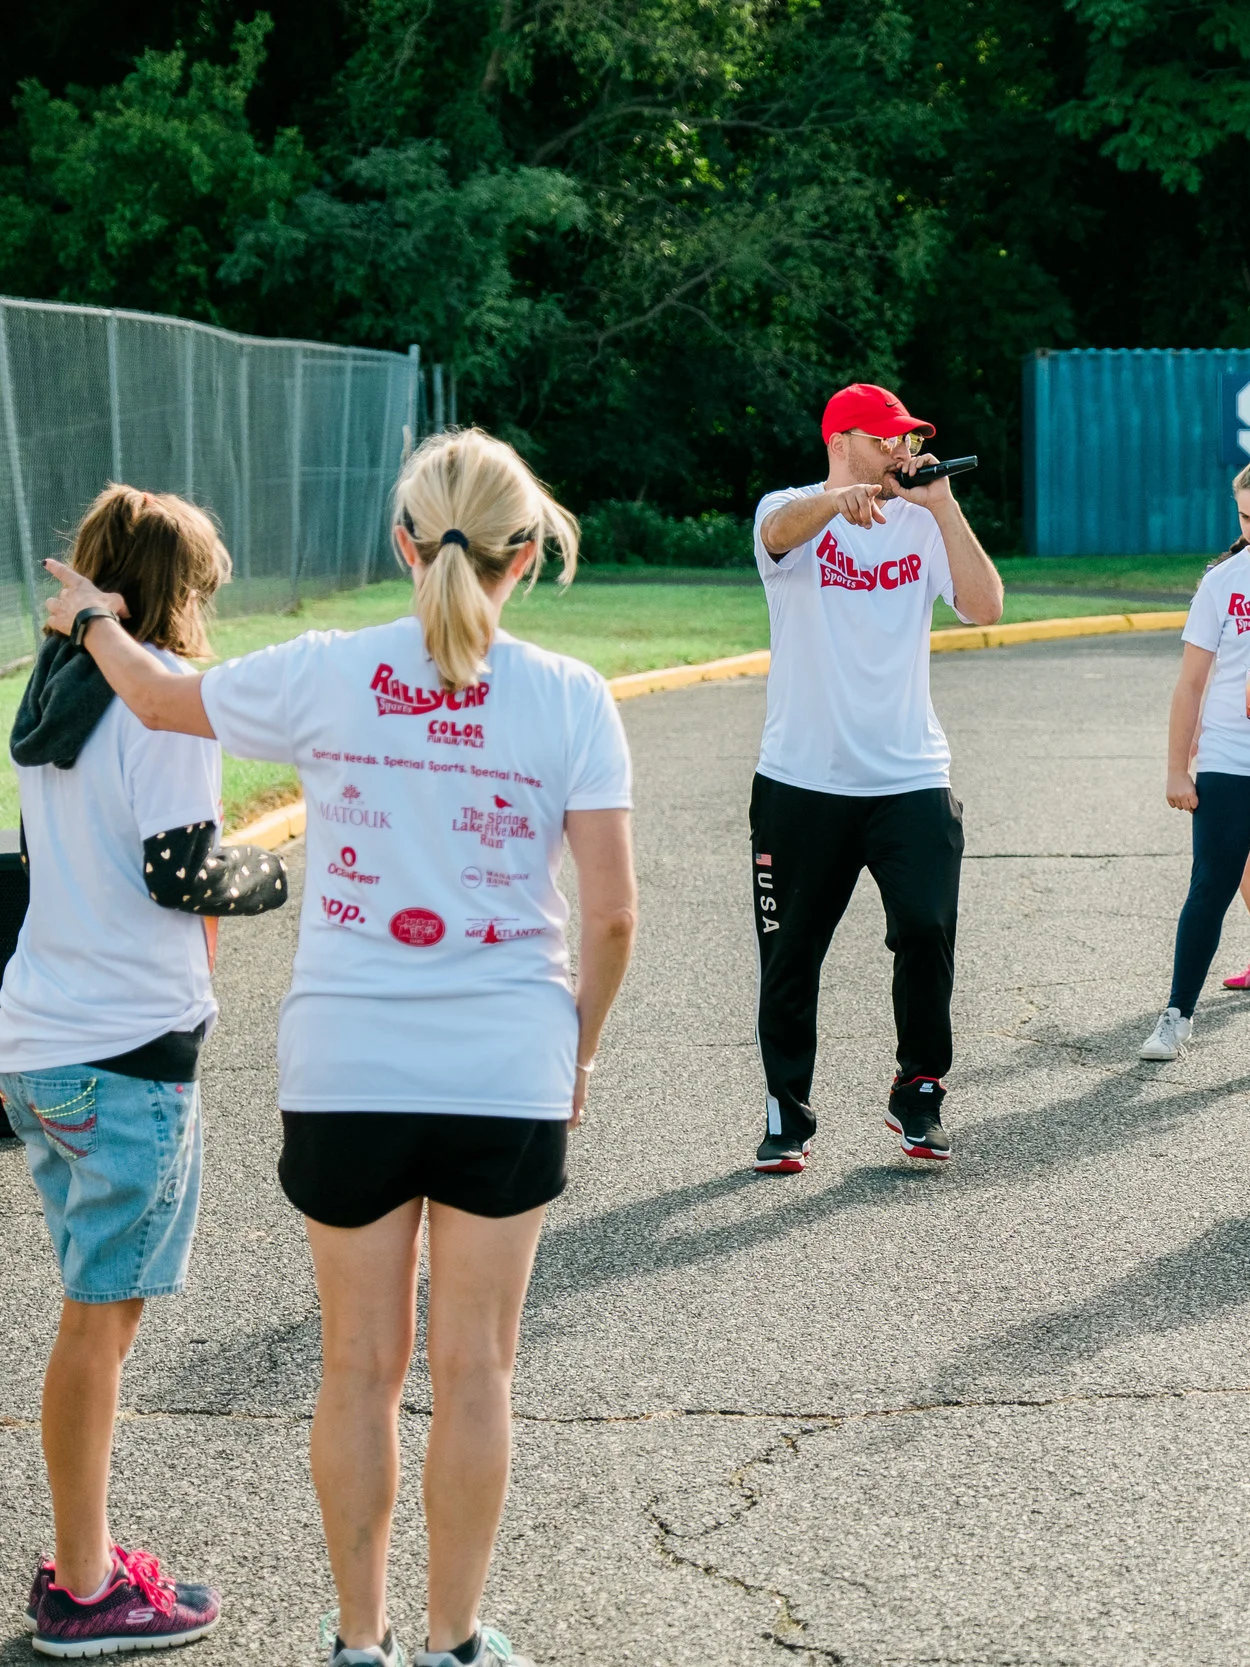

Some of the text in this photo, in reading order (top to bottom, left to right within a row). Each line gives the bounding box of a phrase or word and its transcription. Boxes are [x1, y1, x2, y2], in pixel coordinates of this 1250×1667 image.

[824, 568, 857, 588] Sports
[428, 720, 484, 739] COLOR
[384, 755, 424, 769] Special
[428, 760, 467, 774] Sports.
[470, 764, 510, 780] Special
[461, 806, 529, 830] The Spring
[452, 819, 483, 833] Lake
[508, 825, 536, 840] Mile
[480, 834, 506, 849] Run
[757, 872, 780, 934] USA
